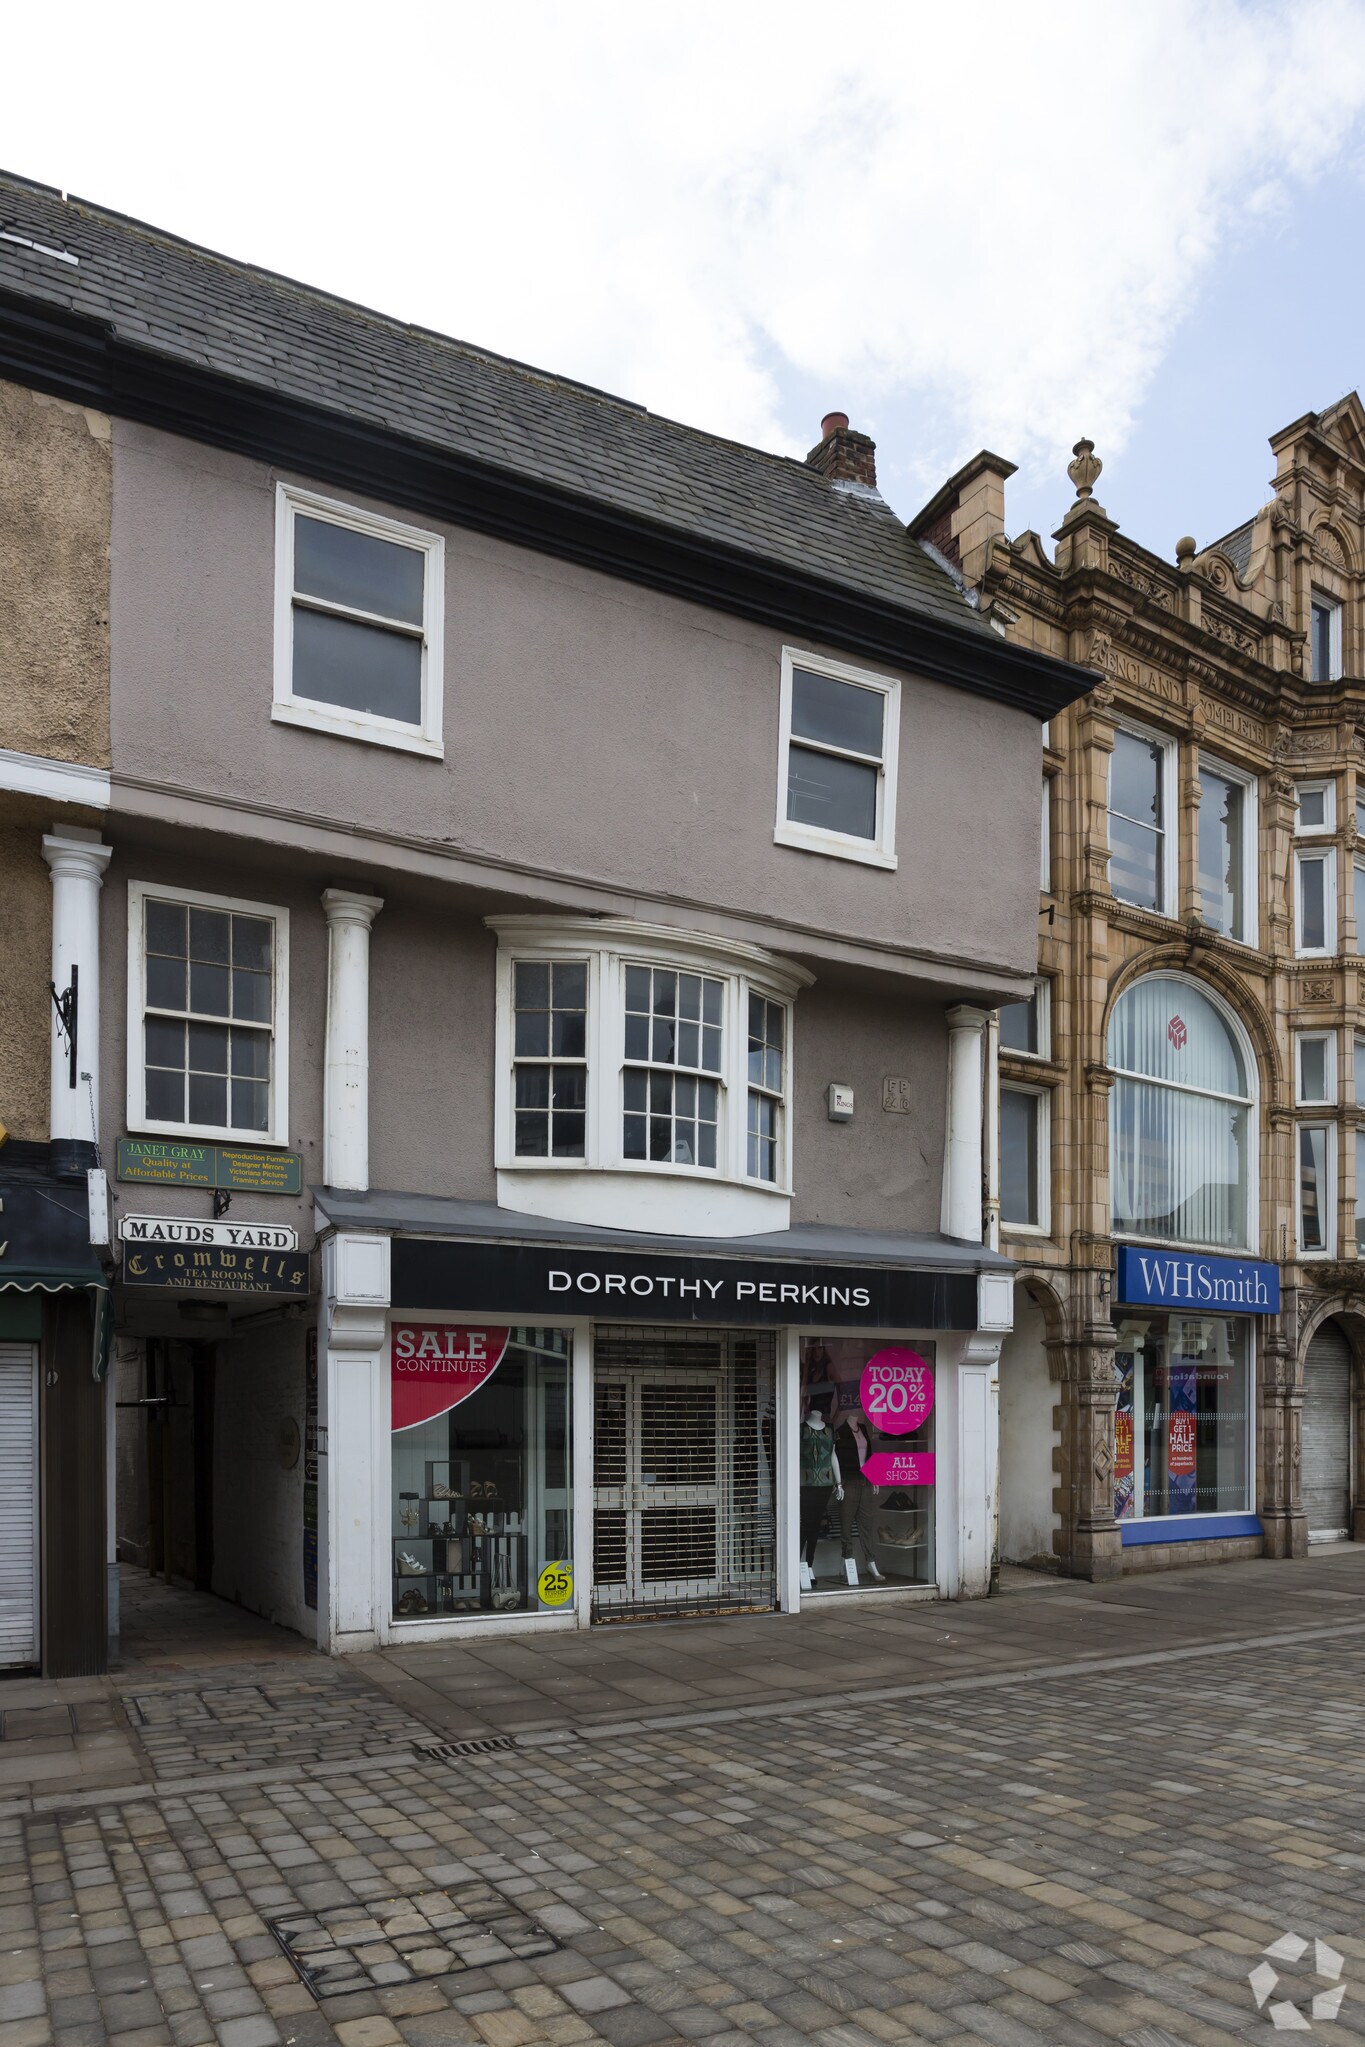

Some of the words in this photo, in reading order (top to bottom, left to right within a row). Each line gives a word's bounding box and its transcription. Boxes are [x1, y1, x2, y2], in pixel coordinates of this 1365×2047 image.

[1106, 651, 1180, 703] ENGLAND
[1200, 698, 1264, 745] OMPLETE
[127, 1143, 168, 1156] JANET
[171, 1147, 206, 1159] GRAY
[142, 1156, 178, 1169] Quality
[222, 1152, 265, 1161] Reproduction
[266, 1155, 294, 1164] Furniture
[232, 1160, 261, 1169] Designer
[262, 1163, 285, 1171] Mirrors
[125, 1167, 176, 1179] Affordable
[180, 1171, 209, 1182] Prices
[262, 1170, 288, 1179] Pictures
[232, 1176, 259, 1185] Framing
[260, 1178, 284, 1187] Service
[129, 1222, 214, 1243] MAUDS
[226, 1229, 288, 1247] YARD
[128, 1250, 305, 1285] Cromwells
[184, 1269, 207, 1278] TEA
[211, 1270, 254, 1281] ROOMS
[1139, 1257, 1269, 1305] WHSmith
[165, 1278, 191, 1287] AND
[194, 1279, 272, 1291] RESTAURANT
[548, 1270, 725, 1299] DOROTHY
[736, 1281, 871, 1307] PERKINS
[395, 1329, 487, 1360] SALE
[396, 1359, 487, 1373] CONTINUES
[869, 1366, 926, 1383] TODAY
[908, 1404, 926, 1413] OFF
[1116, 1426, 1124, 1434] ET
[1173, 1424, 1187, 1433] GET
[1116, 1434, 1132, 1446] ALF
[1169, 1432, 1195, 1444] HALF
[1171, 1443, 1193, 1453] PRICE
[892, 1457, 916, 1468] ALL
[886, 1470, 919, 1481] SHOES
[544, 1573, 568, 1591] 25
